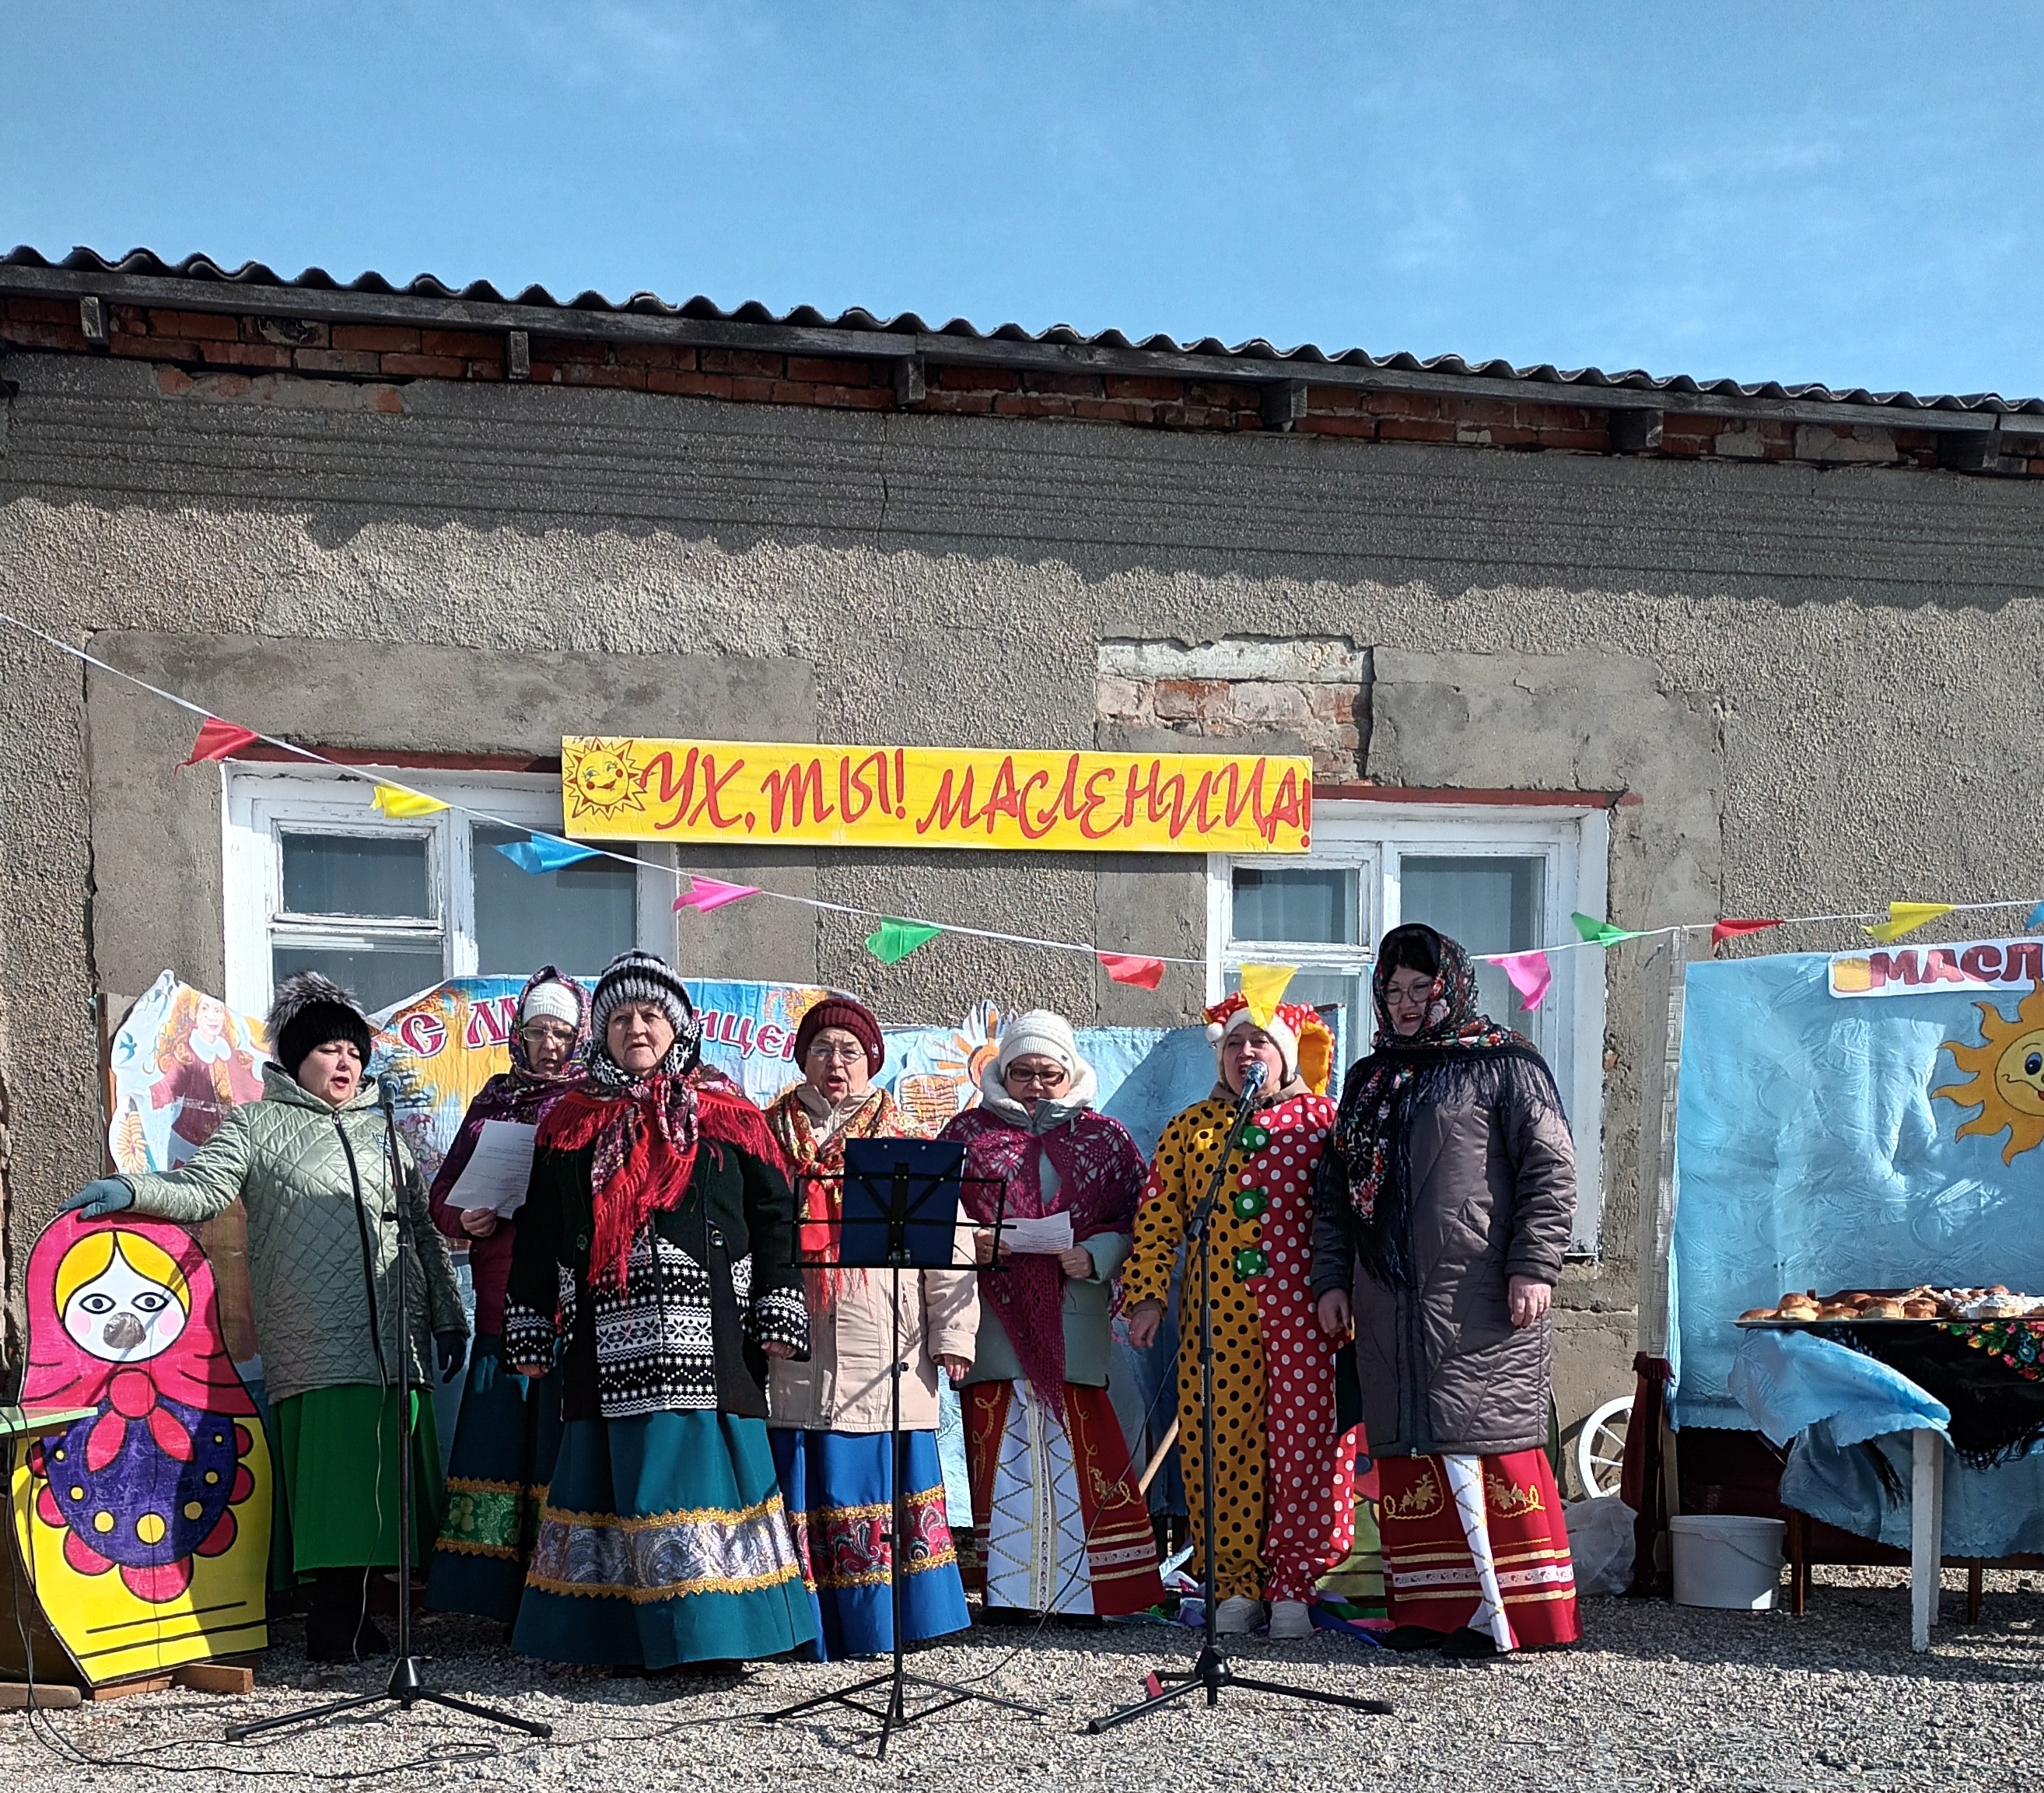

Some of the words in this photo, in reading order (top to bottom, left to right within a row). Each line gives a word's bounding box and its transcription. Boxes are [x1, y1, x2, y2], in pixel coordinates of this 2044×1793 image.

[639, 747, 755, 834] УХ,
[915, 753, 1311, 848] МАСЛЕНИЦА!
[400, 1013, 445, 1056] С
